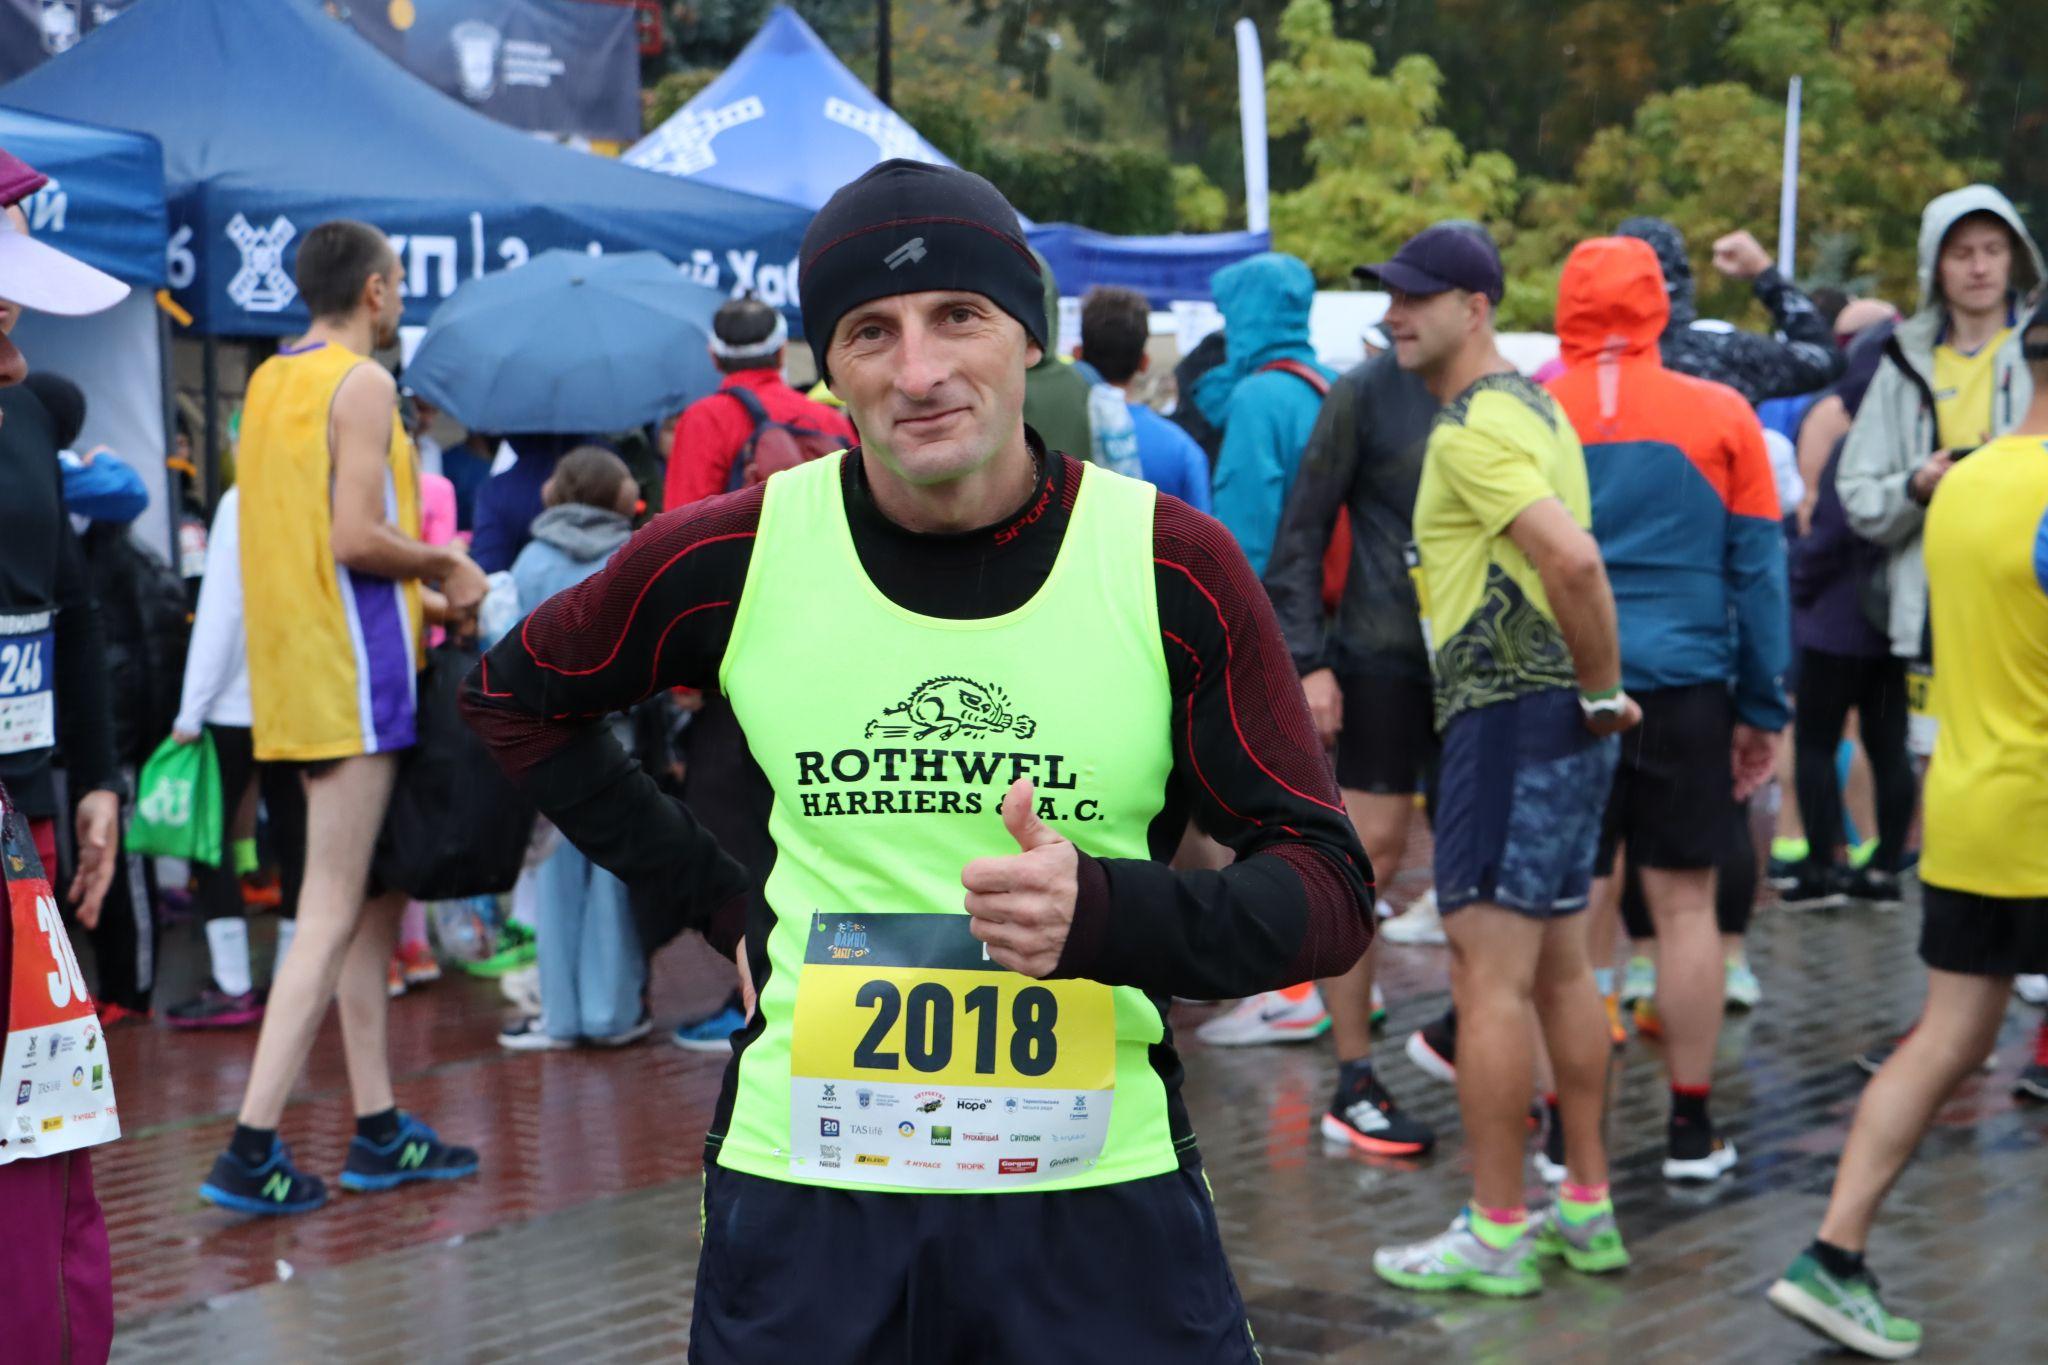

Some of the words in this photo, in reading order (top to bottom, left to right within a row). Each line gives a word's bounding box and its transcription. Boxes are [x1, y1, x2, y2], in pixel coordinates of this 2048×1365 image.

[800, 790, 982, 817] HARRIERS
[853, 979, 1059, 1077] 2018
[823, 1120, 838, 1132] 20
[850, 1124, 868, 1135] TAS
[956, 1162, 985, 1170] TROPIK
